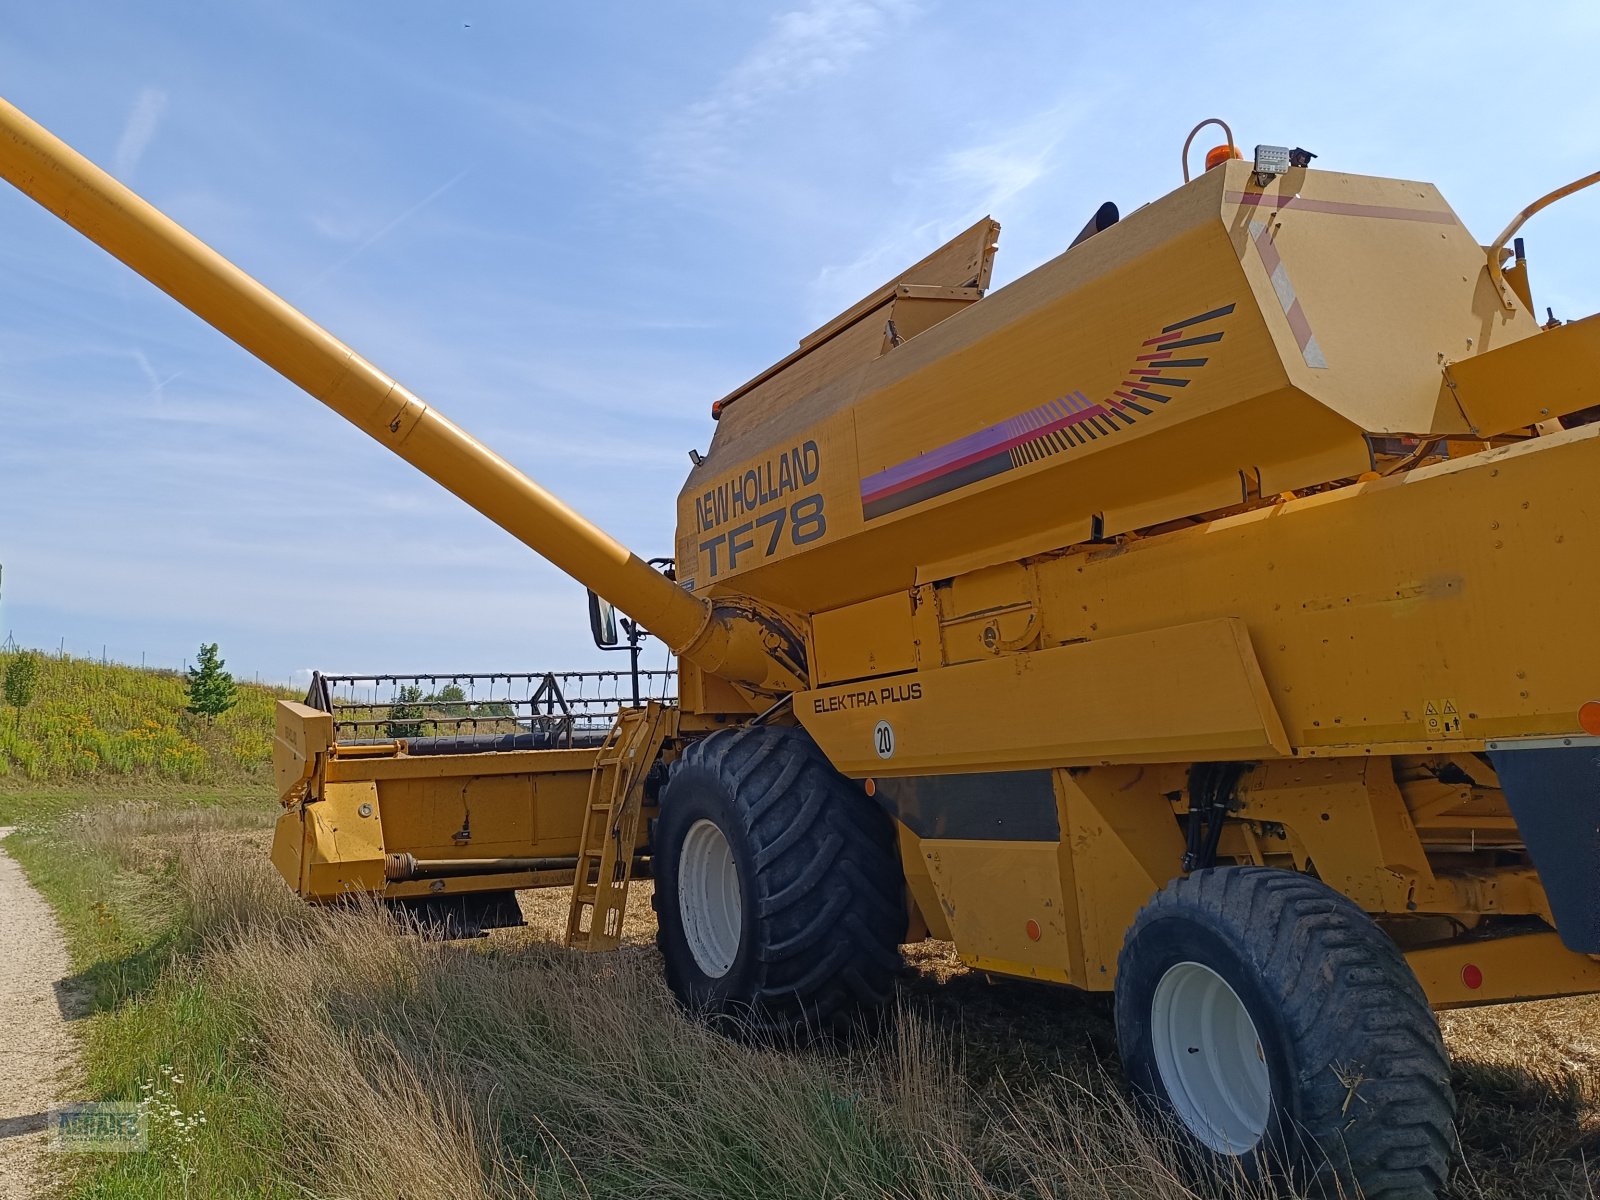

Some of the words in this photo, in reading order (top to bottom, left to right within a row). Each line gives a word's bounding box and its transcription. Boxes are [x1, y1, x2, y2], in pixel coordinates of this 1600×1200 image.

[695, 482, 729, 535] NEW
[731, 440, 820, 519] HOLLAND
[813, 690, 878, 714] ELEKTRA
[880, 682, 922, 704] PLUS
[876, 726, 892, 754] 20
